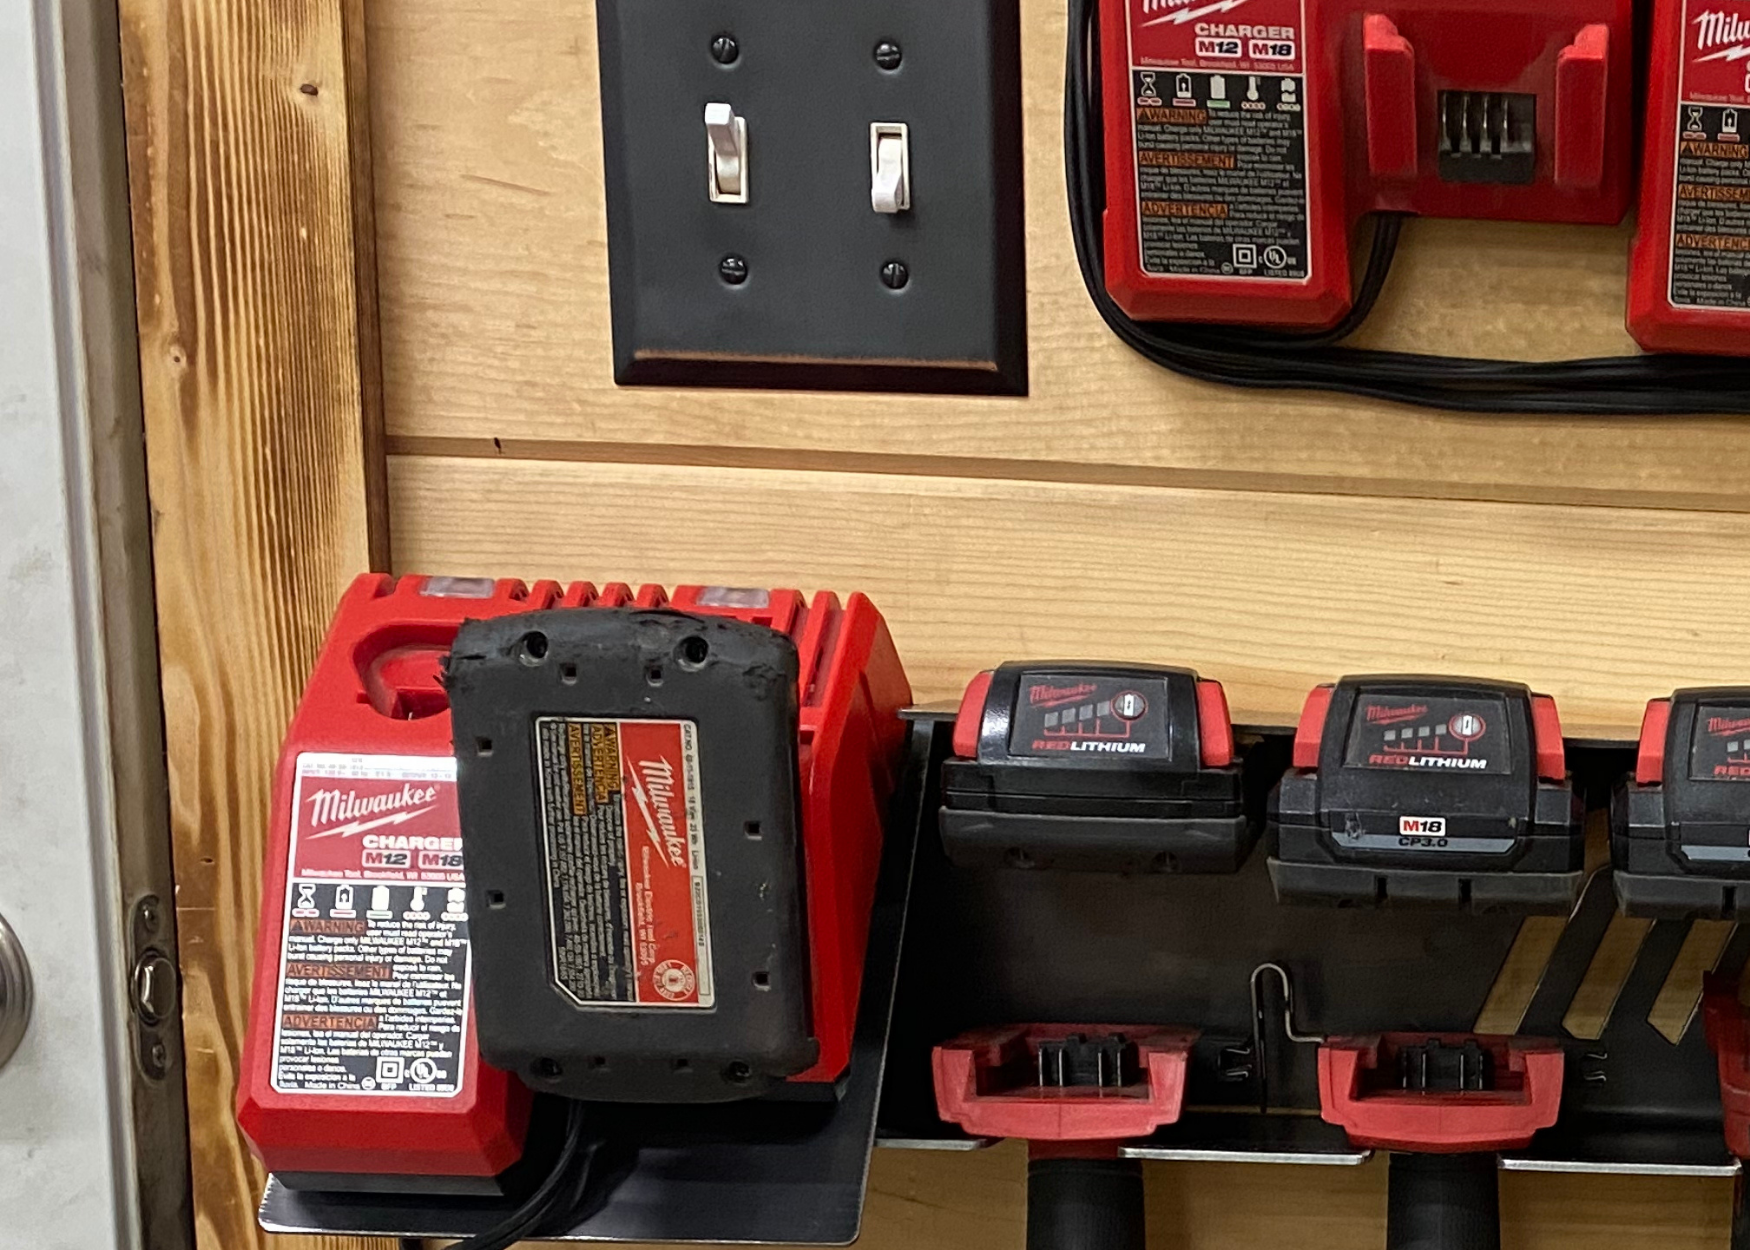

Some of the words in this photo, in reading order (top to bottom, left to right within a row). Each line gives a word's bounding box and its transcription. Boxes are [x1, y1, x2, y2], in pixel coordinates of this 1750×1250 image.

[1194, 22, 1295, 39] CHARGER
[1197, 40, 1240, 55] M12
[1251, 43, 1294, 57] M18
[1149, 108, 1206, 123] WARNING
[1693, 142, 1748, 158] WARNING
[1139, 151, 1235, 168] AVERTISSEMENT
[1142, 202, 1227, 219] ADVERTENCIA
[1366, 704, 1429, 720] Milwaukee
[1032, 740, 1146, 753] REDLITHIUM
[569, 725, 586, 813] AVERTISSEMENT
[592, 725, 607, 800] ADVERTENCIA
[604, 737, 619, 789] WARNING
[1368, 754, 1488, 769] REDLITHIUM
[304, 783, 437, 827] Milwaukee
[639, 755, 687, 867] Milwaukee
[1402, 818, 1443, 834] M18
[1398, 837, 1448, 848] CP3.0
[364, 852, 408, 866] M12
[421, 854, 463, 867] M18
[303, 919, 365, 934] WARNING
[287, 963, 389, 978] AVERTISSEMENT
[284, 1015, 376, 1028] ADVERTENCIA
